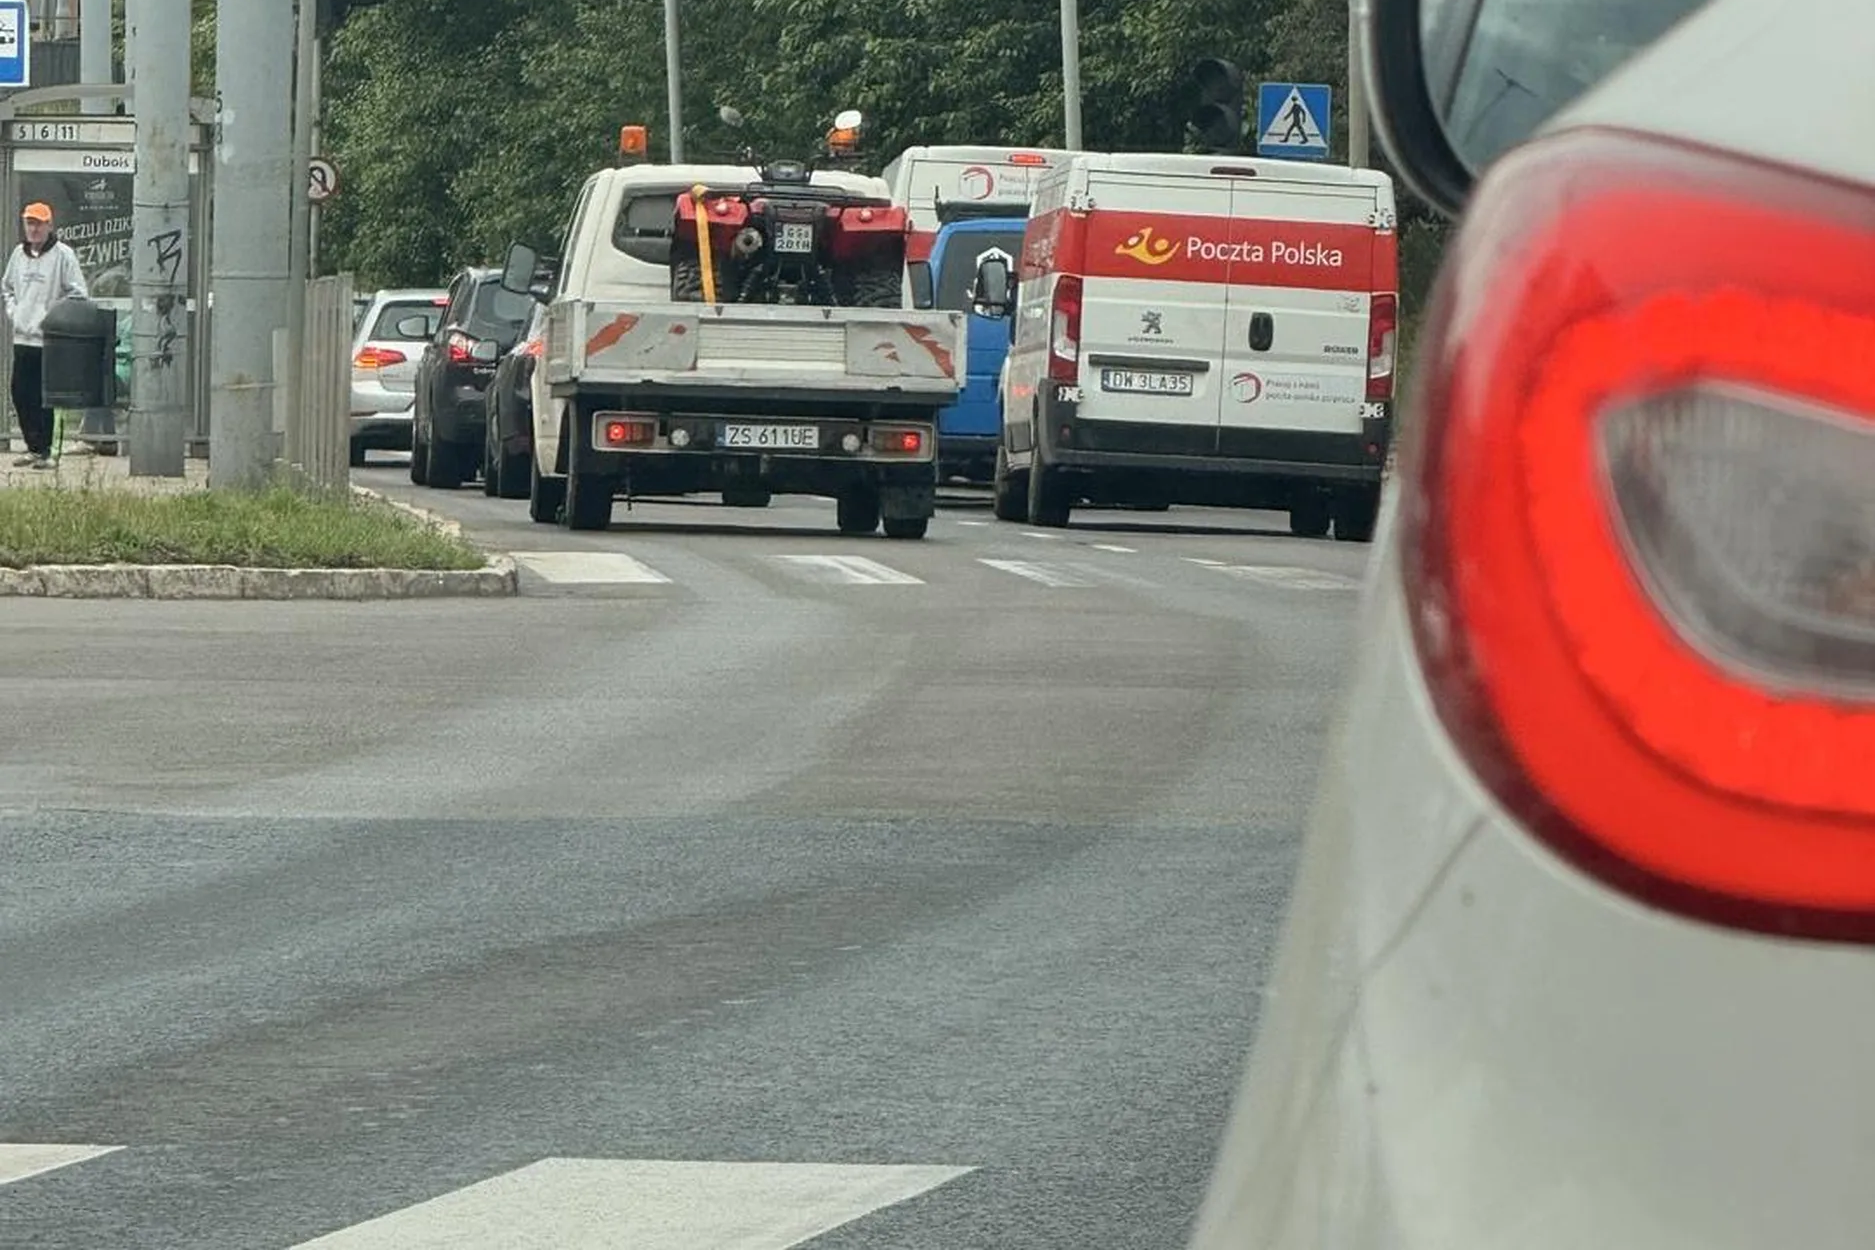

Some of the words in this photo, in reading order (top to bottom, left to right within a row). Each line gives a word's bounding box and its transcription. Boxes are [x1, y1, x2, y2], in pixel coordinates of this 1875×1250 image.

[19, 125, 26, 139] 5
[41, 125, 49, 139] 6
[61, 126, 74, 139] 11
[82, 155, 129, 167] Dubois
[56, 220, 101, 241] POCZUJ
[105, 216, 132, 234] DZIK
[1186, 236, 1264, 262] Poczta
[1271, 240, 1343, 266] Polska
[1113, 372, 1133, 387] DW
[728, 426, 752, 445] ZS
